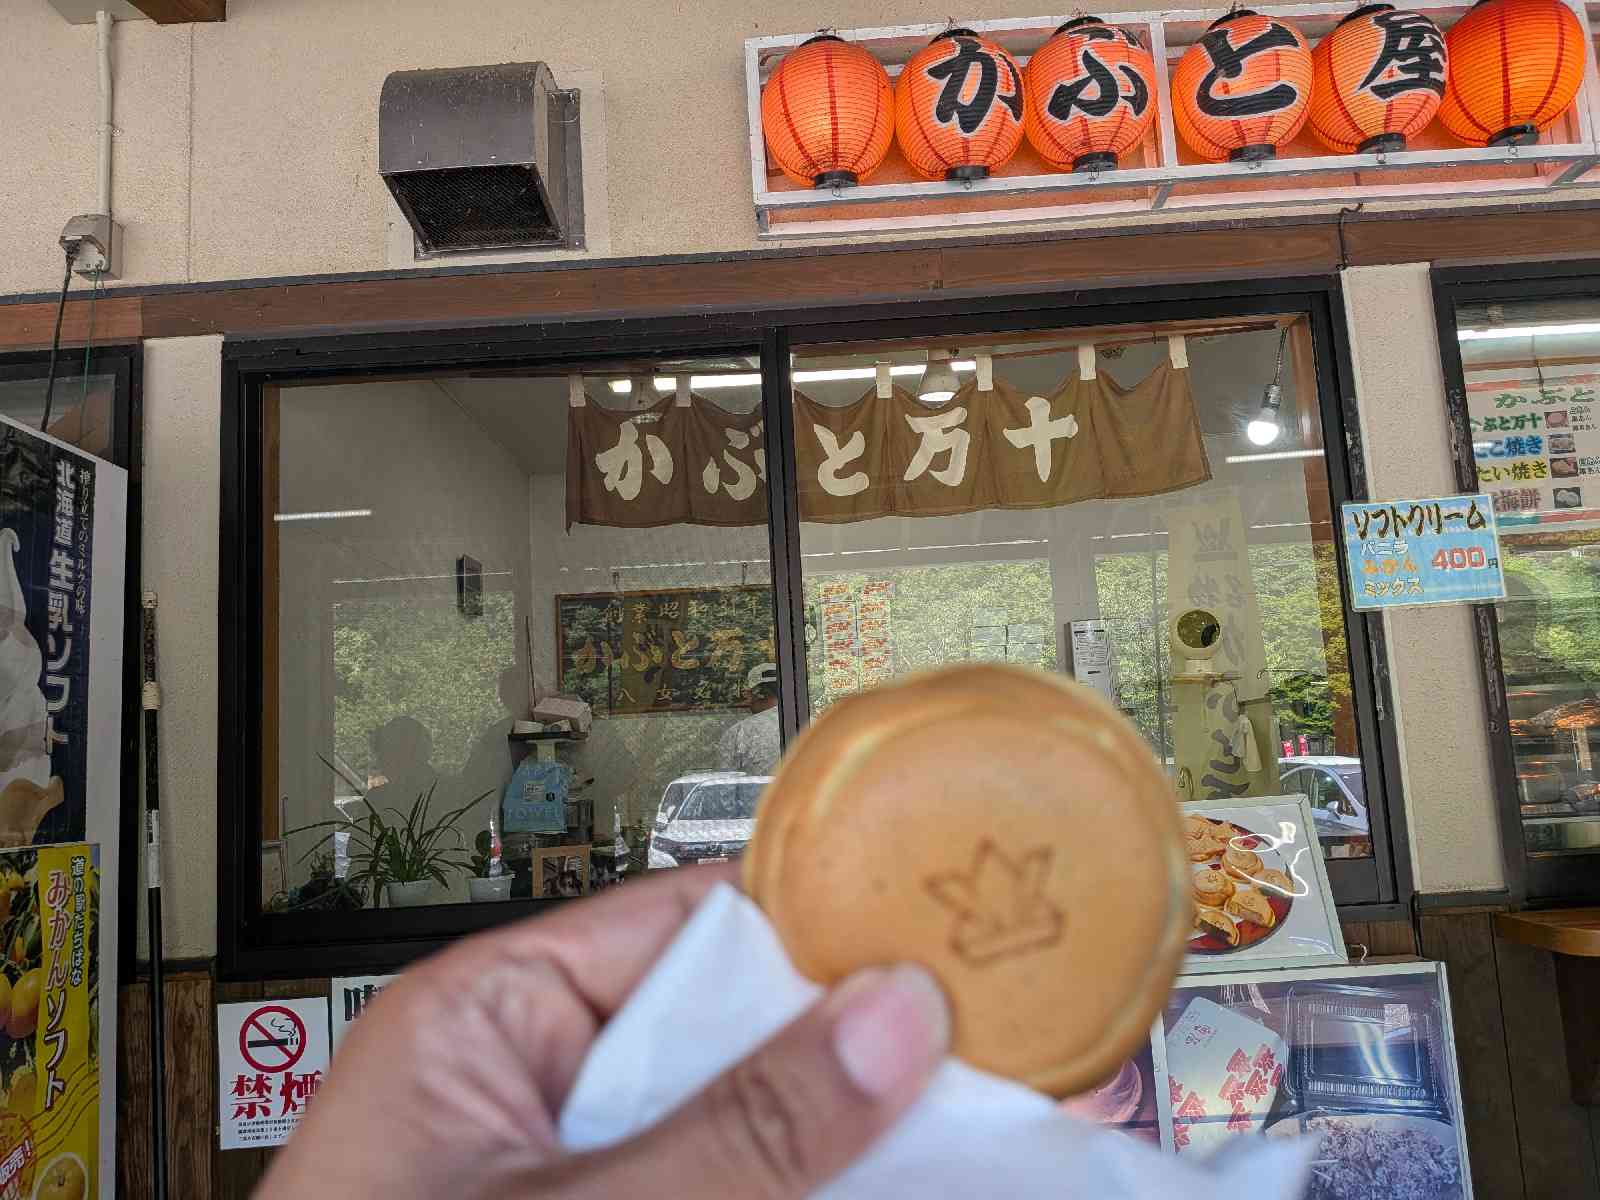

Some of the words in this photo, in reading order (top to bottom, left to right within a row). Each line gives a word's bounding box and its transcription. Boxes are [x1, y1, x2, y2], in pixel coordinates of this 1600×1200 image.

[595, 395, 1080, 501] かぶと万十
[1352, 499, 1487, 540] ソフトクリーム
[1361, 539, 1409, 556] バニラ
[1364, 577, 1425, 597] ミックス
[70, 856, 87, 987] 道の駅たちばな
[44, 871, 71, 1111] みかんソフト
[230, 1069, 322, 1120] 禁煙
